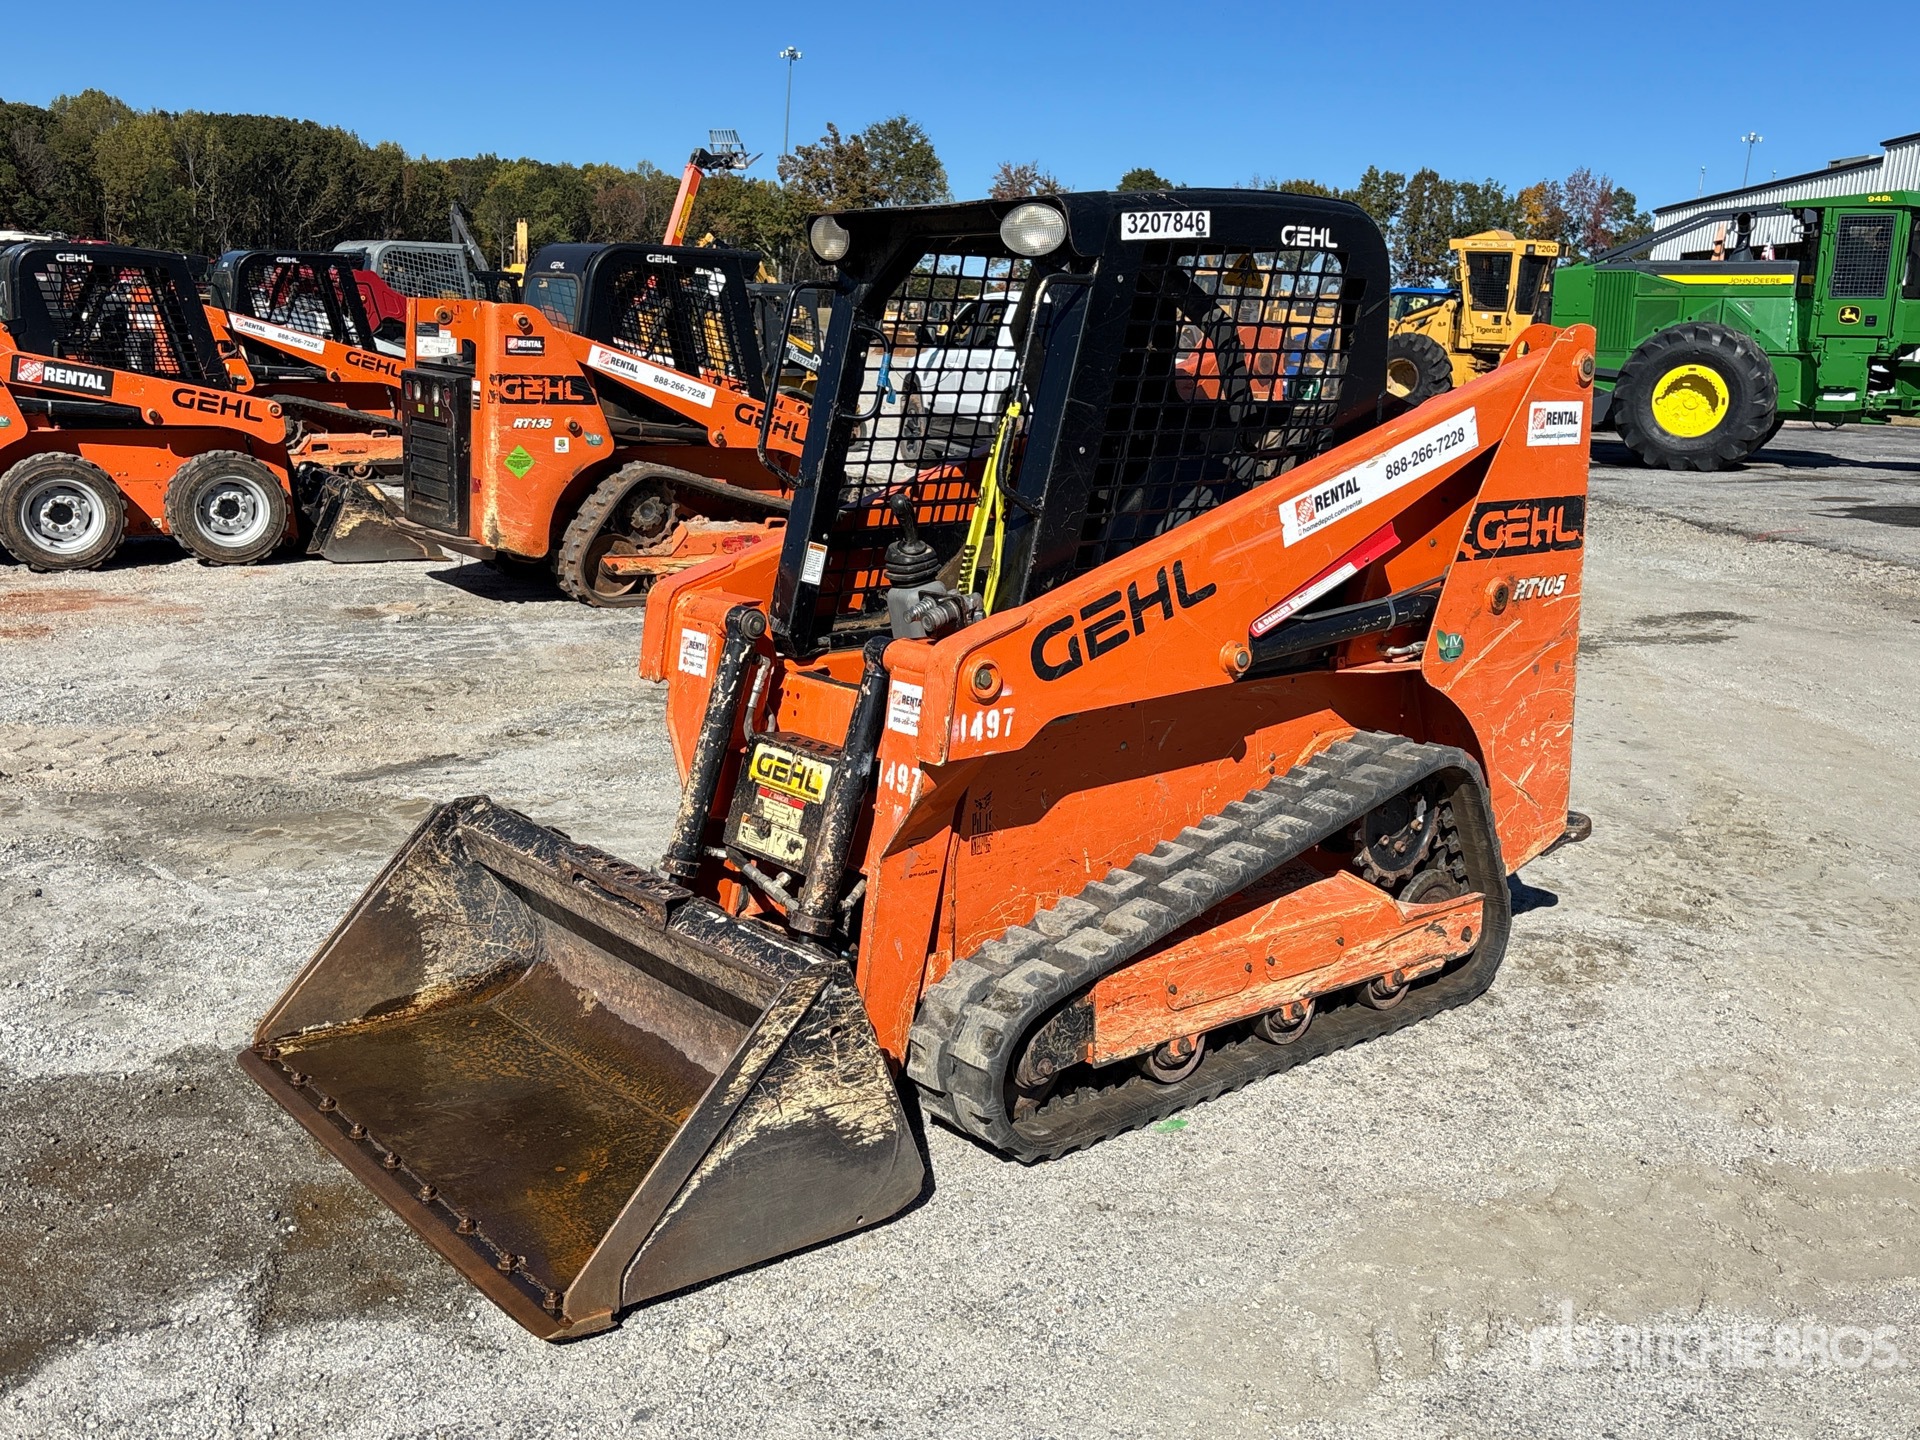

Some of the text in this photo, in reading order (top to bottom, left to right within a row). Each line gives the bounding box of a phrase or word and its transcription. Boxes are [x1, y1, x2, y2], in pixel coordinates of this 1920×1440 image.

[1867, 195, 1893, 203] 948L
[1127, 212, 1206, 234] 3207846
[1281, 225, 1338, 249] GEHL
[56, 253, 94, 263] GEHL
[276, 256, 300, 264] GEHL
[646, 254, 677, 264] GEHL
[1728, 276, 1781, 284] JOHN DEERE
[244, 321, 266, 332] RENTAL
[1476, 326, 1503, 335] Tigercat
[517, 340, 542, 348] RENTAL
[345, 351, 401, 378] GEHL
[610, 357, 639, 373] RENTAL
[44, 366, 106, 390] RENTAL
[499, 378, 584, 400] GEHL
[653, 375, 706, 399] 888-266-7228
[172, 387, 264, 422] GEHL
[513, 418, 553, 429] RT135
[1546, 411, 1578, 425] RENTAL
[1385, 427, 1465, 480] 888-266-7228
[1314, 476, 1361, 513] RENTAL
[1302, 498, 1363, 534] homedepot.com/rental
[1476, 504, 1580, 551] GEHL
[1512, 574, 1568, 601] RT105
[1030, 559, 1217, 682] GEHL
[1263, 603, 1292, 626] DANGER
[960, 708, 1015, 743] 1497
[756, 752, 819, 795] GEHL
